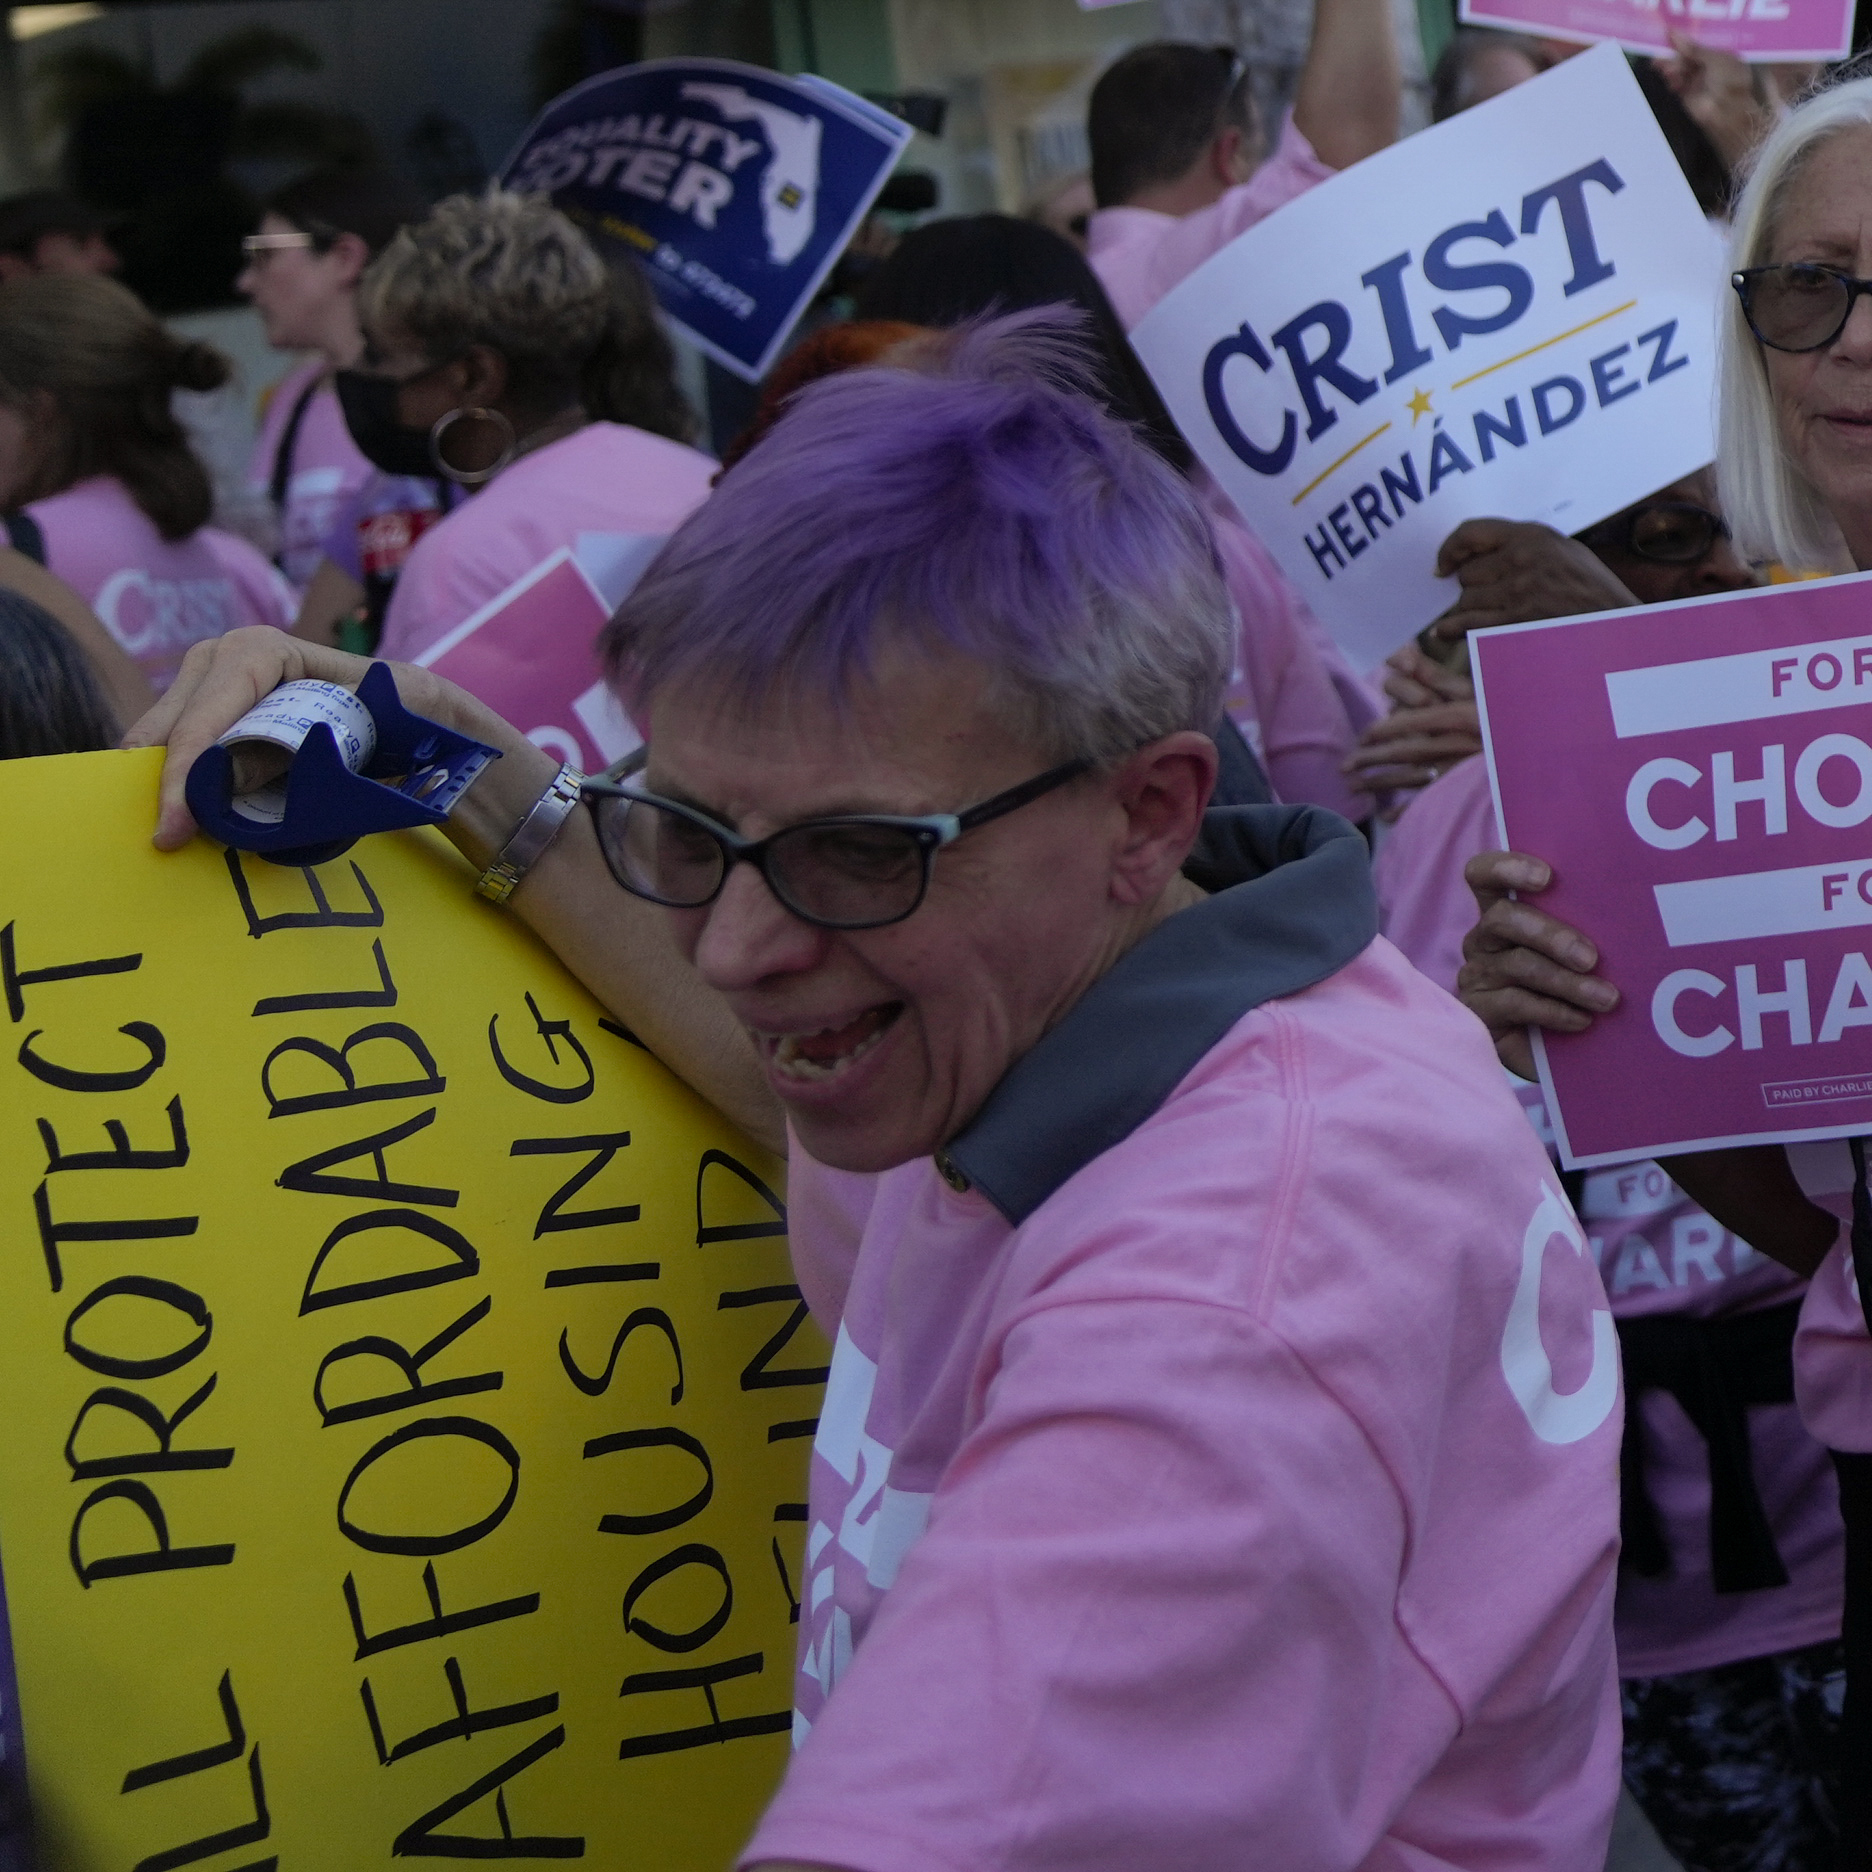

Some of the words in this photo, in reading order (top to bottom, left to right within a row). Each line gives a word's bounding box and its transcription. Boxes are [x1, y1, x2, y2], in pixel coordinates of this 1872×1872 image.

[1202, 157, 1625, 477] CRIST
[1304, 319, 1689, 581] HERNÁNDEZ
[1616, 1169, 1676, 1205] FO
[1773, 1084, 1802, 1101] PAID
[1803, 1083, 1821, 1097] BY
[3, 921, 236, 1589] PROTECT
[224, 845, 586, 1860] AFFORDABLE
[490, 992, 794, 1761] HOUSING
